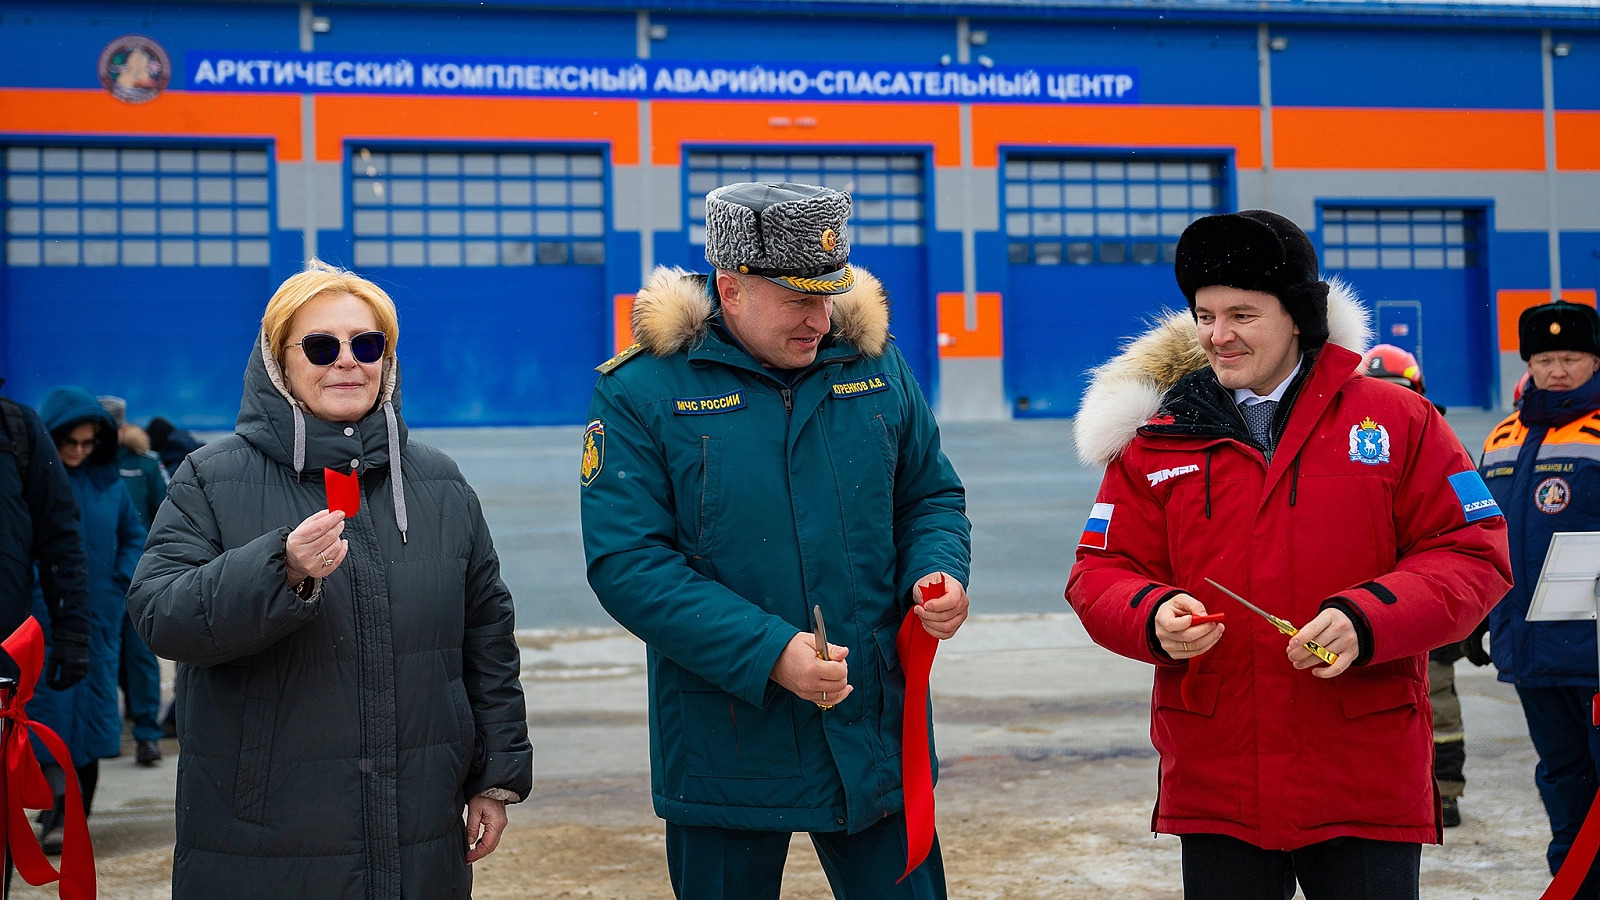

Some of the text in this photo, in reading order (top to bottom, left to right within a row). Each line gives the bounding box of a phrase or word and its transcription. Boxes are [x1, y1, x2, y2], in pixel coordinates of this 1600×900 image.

[194, 59, 415, 87] АРКТИЧЕСКИЙ
[421, 62, 648, 92] КОМПЛЕКСНЫЙ
[653, 65, 1040, 97] АВАРИЙНО-СПАСАТЕЛЬНЫЙ
[1046, 74, 1133, 100] ЦЕНТР
[868, 377, 886, 389] А.В.
[676, 393, 741, 411] МЧС РОССИИ
